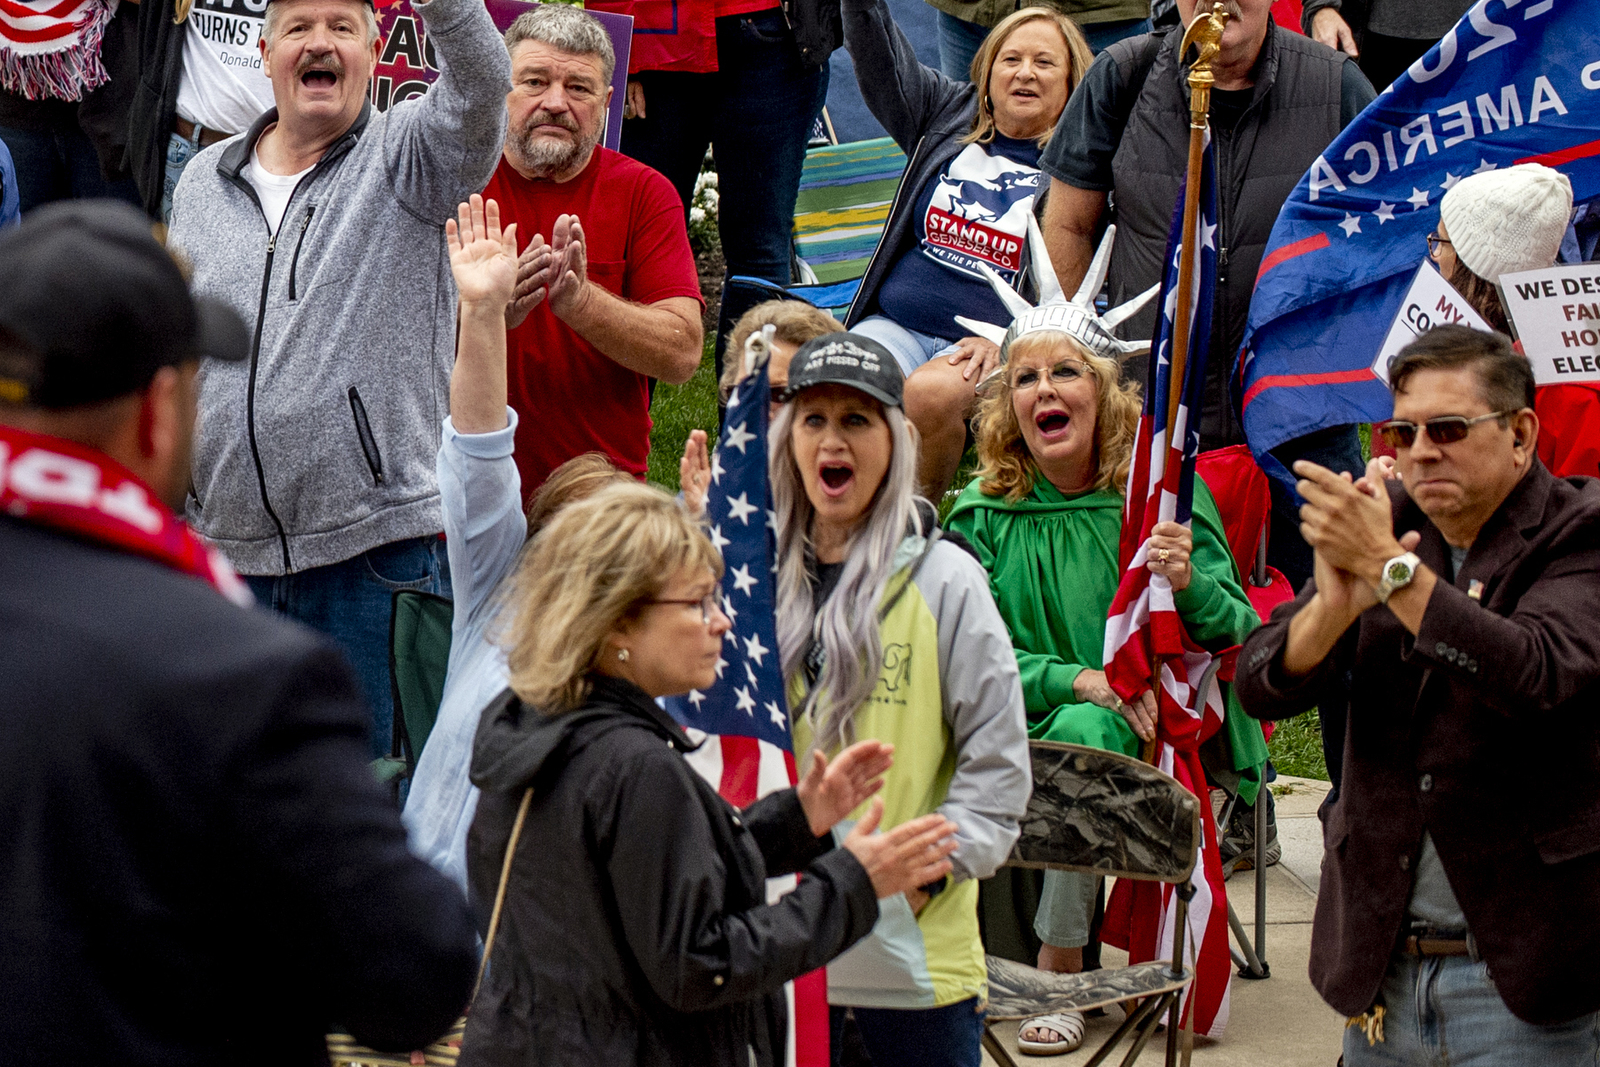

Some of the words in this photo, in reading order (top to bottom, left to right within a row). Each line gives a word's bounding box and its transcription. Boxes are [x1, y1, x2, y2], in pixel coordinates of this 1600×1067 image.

[192, 11, 251, 47] TURNS
[219, 50, 262, 69] Donald
[928, 212, 989, 247] STAND
[990, 235, 1019, 256] UP
[929, 231, 991, 257] GENESEE
[992, 251, 1015, 270] CO.
[931, 246, 946, 257] WE
[946, 252, 965, 264] THE
[965, 259, 1001, 276] PELE
[1515, 279, 1558, 301] WE
[1434, 294, 1464, 325] MY
[804, 357, 824, 372] ARE
[825, 355, 860, 367] PISSED
[860, 360, 881, 372] OFF
